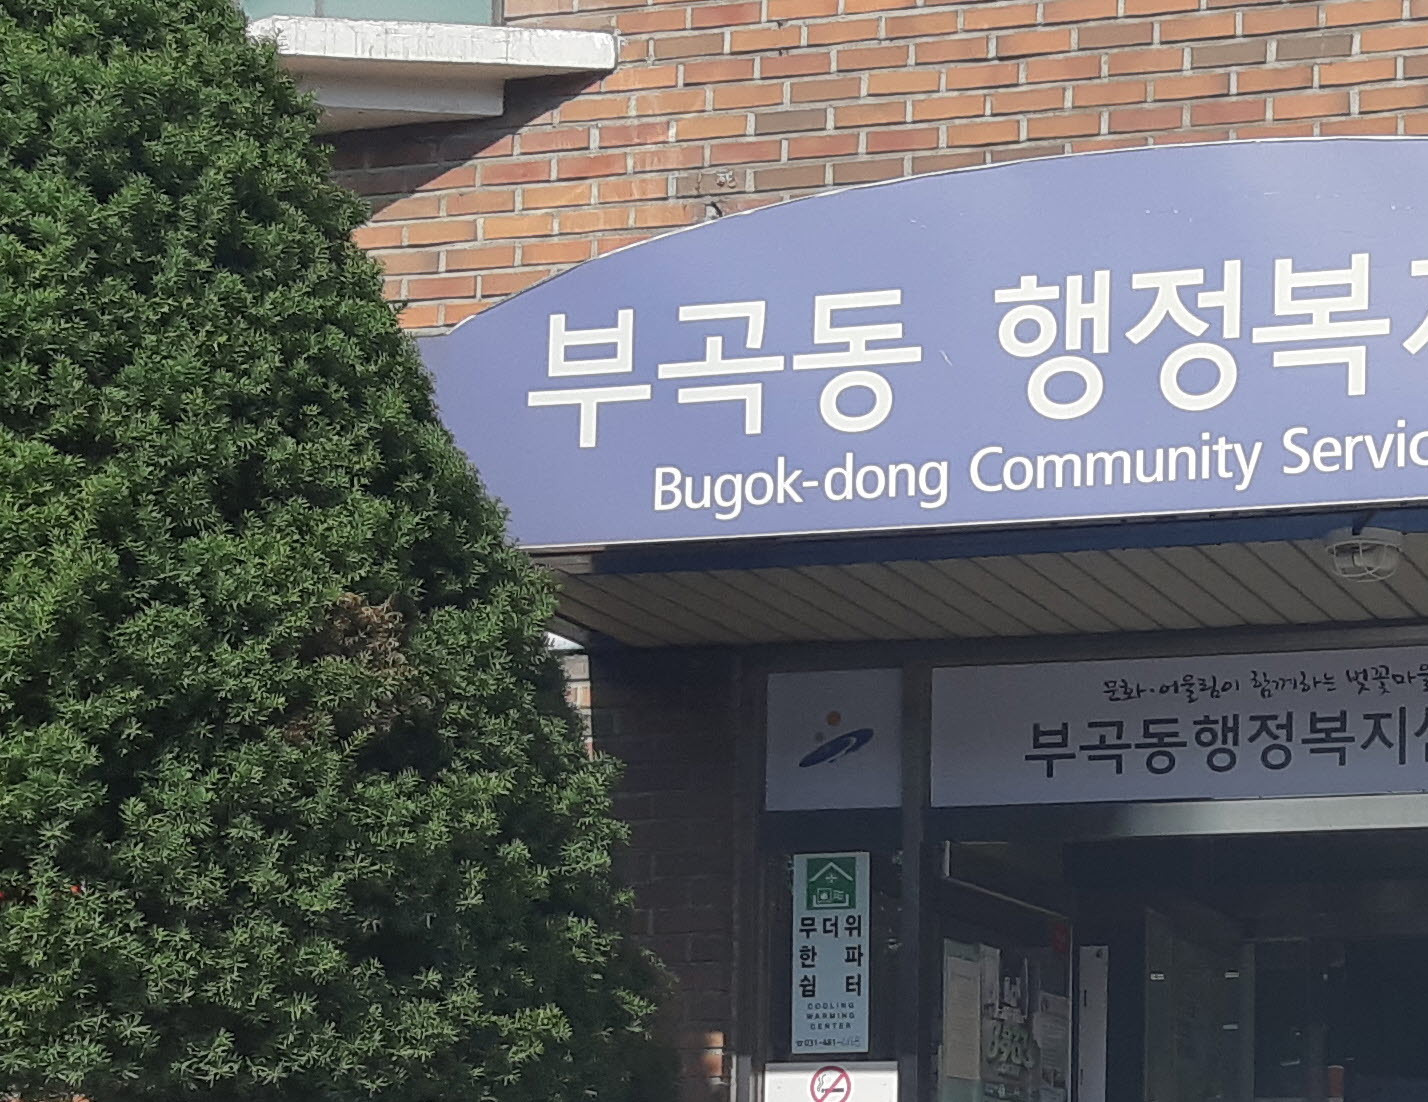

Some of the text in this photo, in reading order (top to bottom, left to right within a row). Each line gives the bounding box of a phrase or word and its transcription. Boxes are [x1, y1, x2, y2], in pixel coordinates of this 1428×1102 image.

[528, 288, 922, 448] 부곡동
[653, 455, 949, 519] Bugok-dong
[969, 431, 1263, 492] Community
[1250, 670, 1336, 698] 함께하는
[800, 914, 861, 938] 무더위
[807, 1012, 855, 1020] WARMING
[808, 1002, 854, 1010] COOLING
[811, 1022, 851, 1030] CENTER
